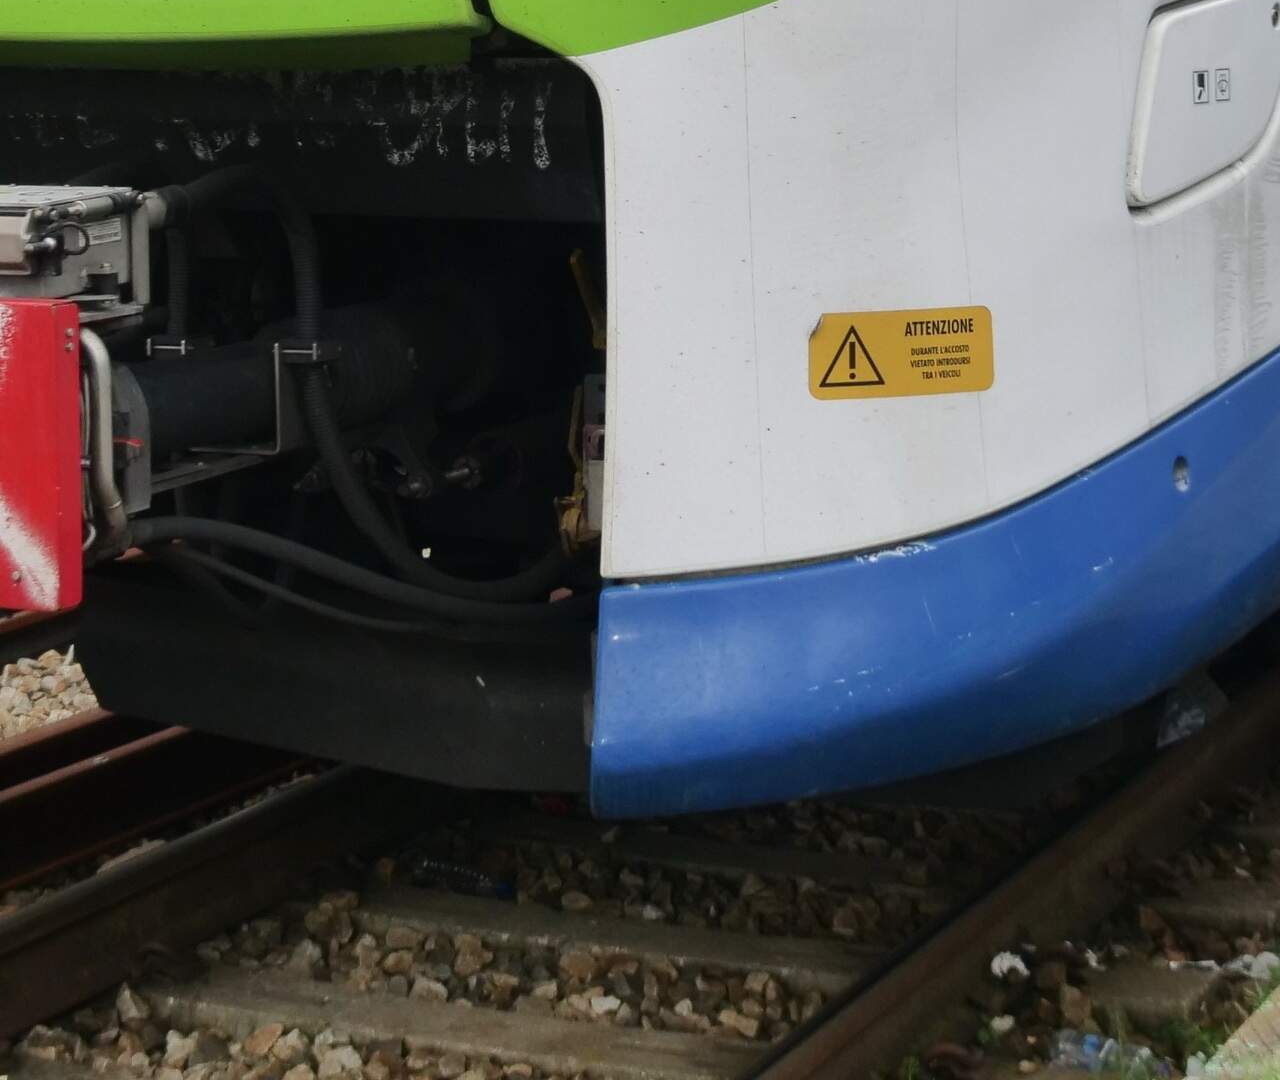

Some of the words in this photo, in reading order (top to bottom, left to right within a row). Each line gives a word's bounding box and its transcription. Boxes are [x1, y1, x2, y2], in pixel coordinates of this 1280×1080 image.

[905, 318, 974, 336] ATTENZIONE
[911, 347, 938, 356] DURANTE
[940, 345, 969, 354] L'ACCOSTO
[910, 359, 935, 368] VIETATO
[922, 371, 933, 379] TRA
[938, 370, 961, 379] VEICOLI
